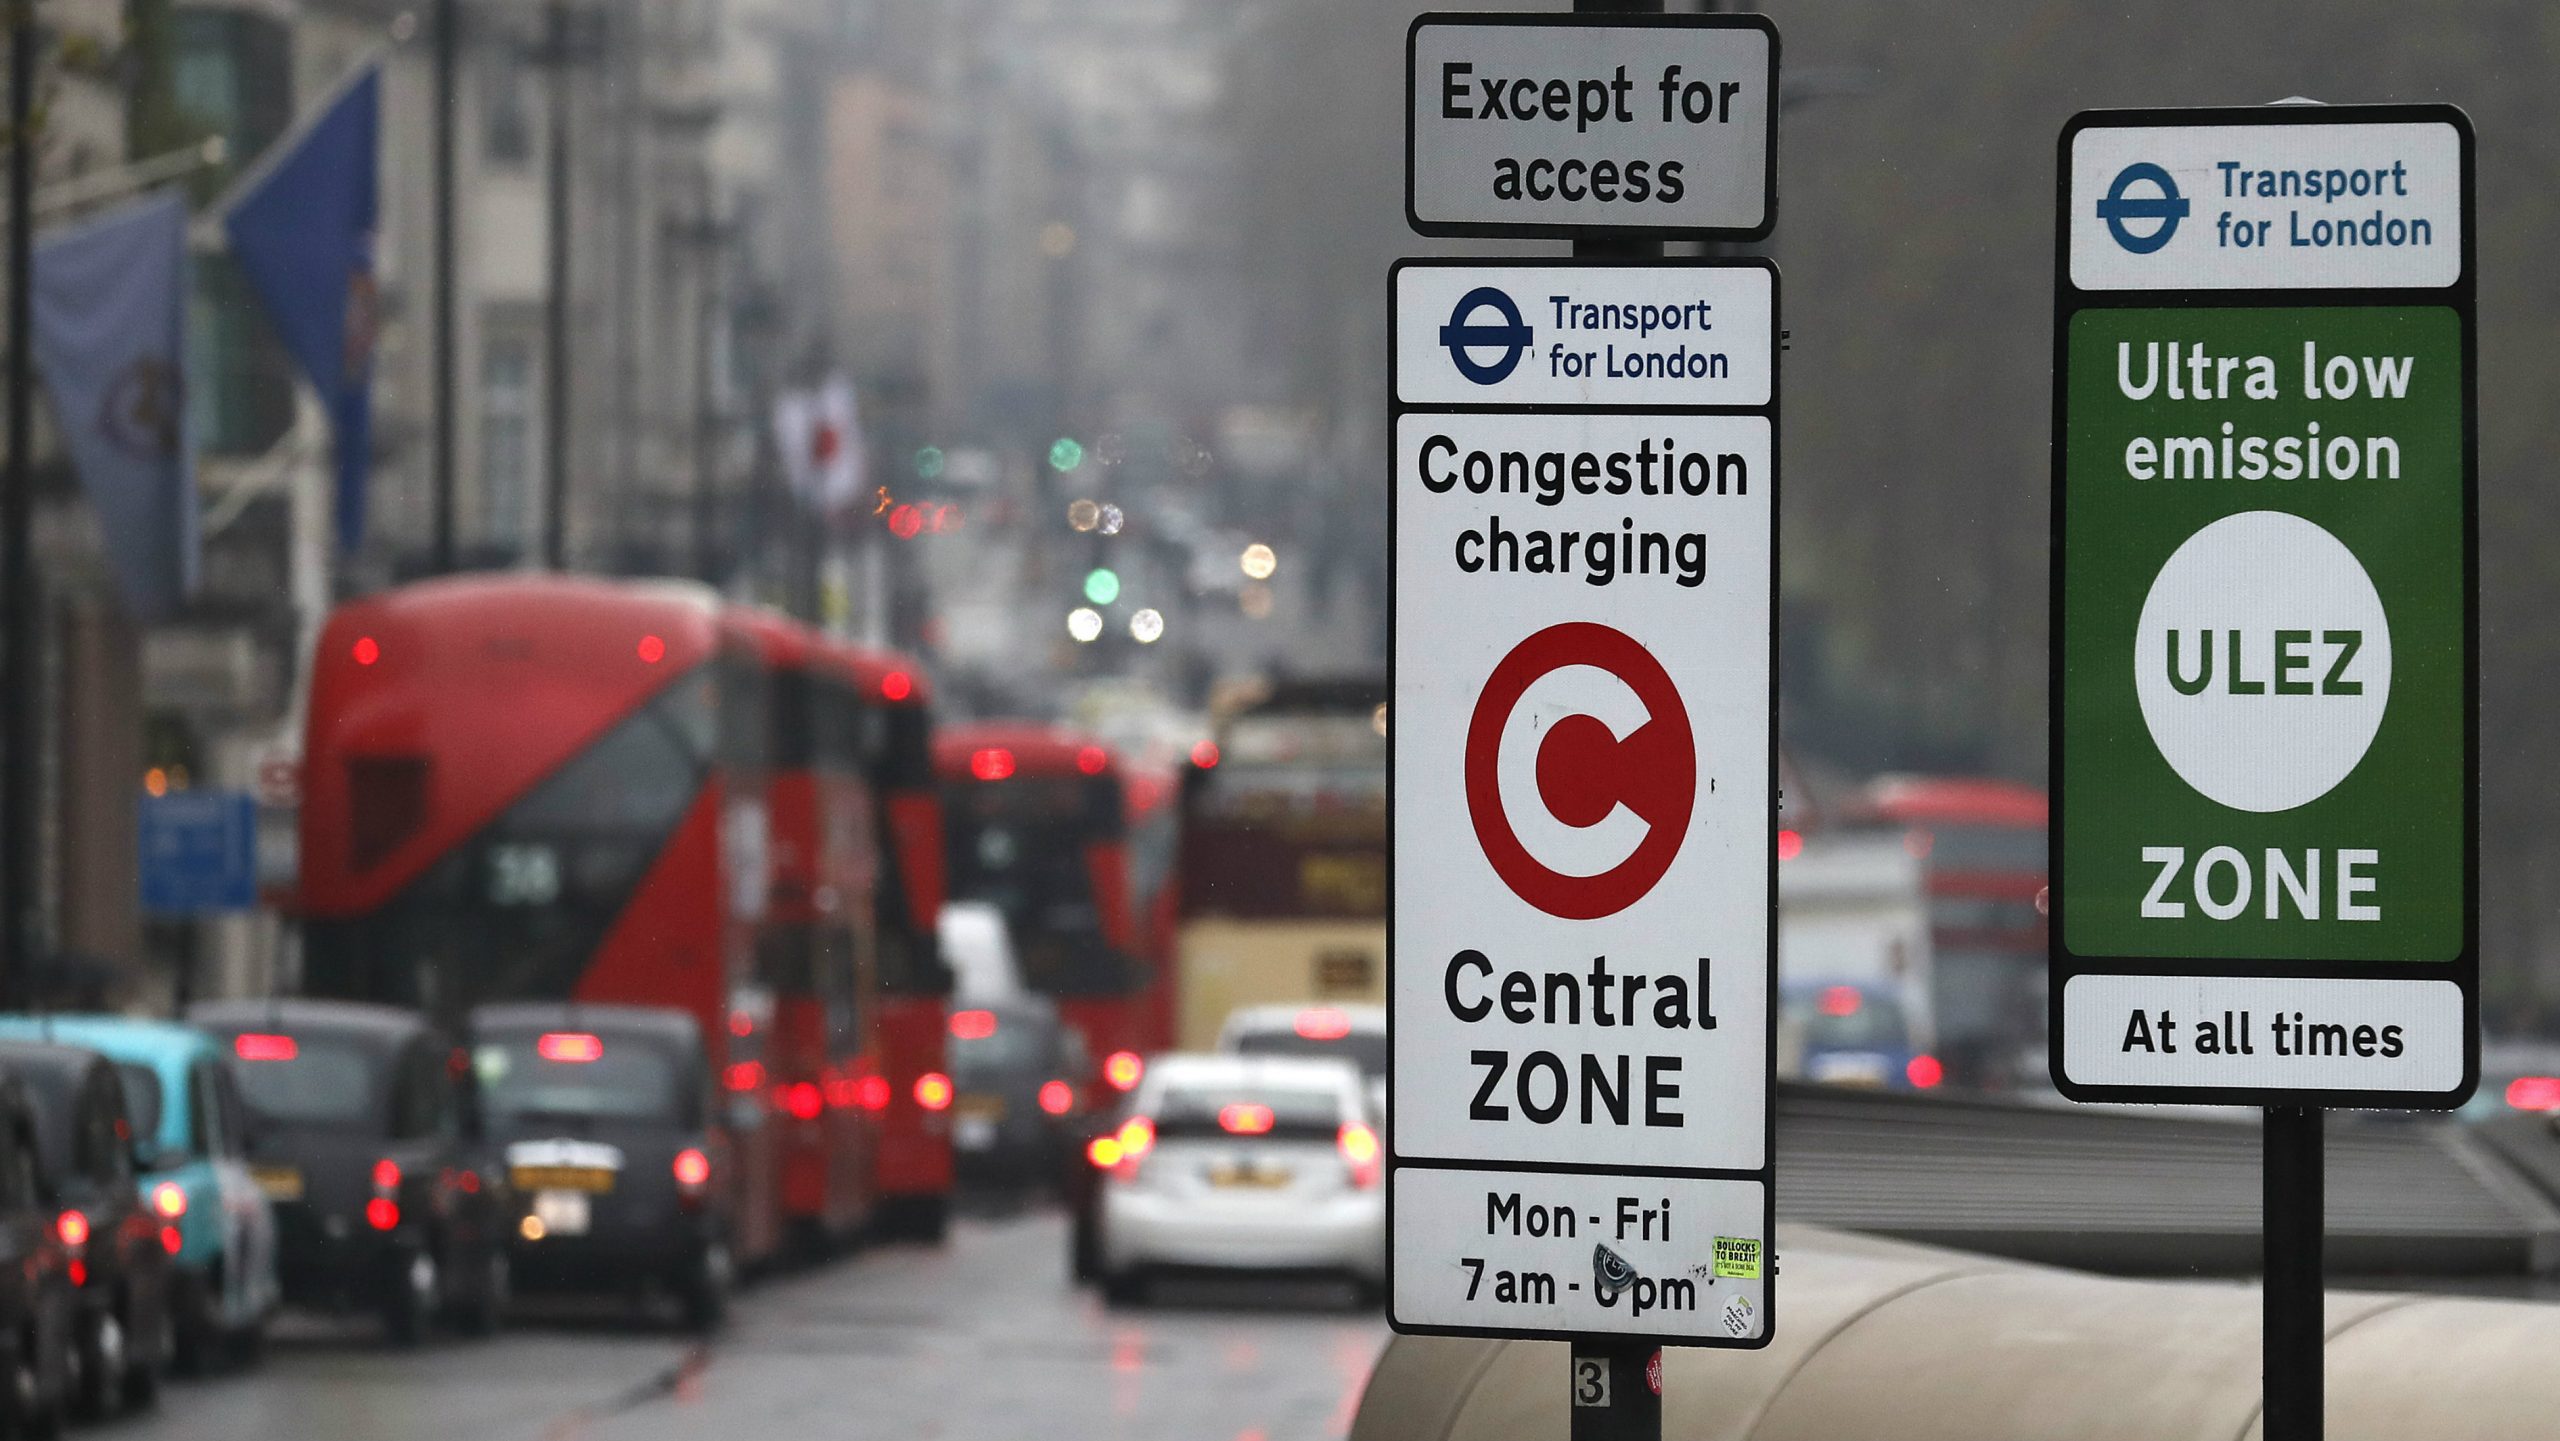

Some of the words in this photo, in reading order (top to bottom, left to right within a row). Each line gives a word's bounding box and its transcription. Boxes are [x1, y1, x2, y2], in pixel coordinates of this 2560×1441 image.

[1442, 62, 1633, 133] Except
[1659, 65, 1740, 123] for
[1493, 158, 1685, 203] access
[2217, 160, 2407, 203] Transport
[2217, 211, 2271, 248] for
[2290, 210, 2431, 247] London
[1549, 296, 1712, 338] Transport
[1549, 343, 1597, 378] for
[1607, 344, 1728, 378] London
[2118, 341, 2279, 400] Ultra
[2304, 341, 2414, 400] low
[1418, 434, 1747, 506] Congestion
[2125, 421, 2400, 480] emission
[1455, 515, 1706, 587] charging
[2166, 629, 2363, 696] ULEZ
[2141, 845, 2381, 921] ZONE
[1444, 949, 1717, 1030] Central
[2122, 1010, 2176, 1053] At
[2195, 1010, 2254, 1055] all
[2272, 1011, 2404, 1058] times
[1469, 1050, 1684, 1127] ZONE
[1487, 1192, 1576, 1237] Mon
[1616, 1198, 1671, 1241] Fri
[1715, 1250, 1726, 1260] TO
[1728, 1252, 1756, 1262] BREXIT
[1717, 1241, 1756, 1252] BOLLOCKS
[1723, 1319, 1738, 1336] FUTURE
[1726, 1314, 1735, 1324] FOR
[1578, 1361, 1604, 1404] 3
